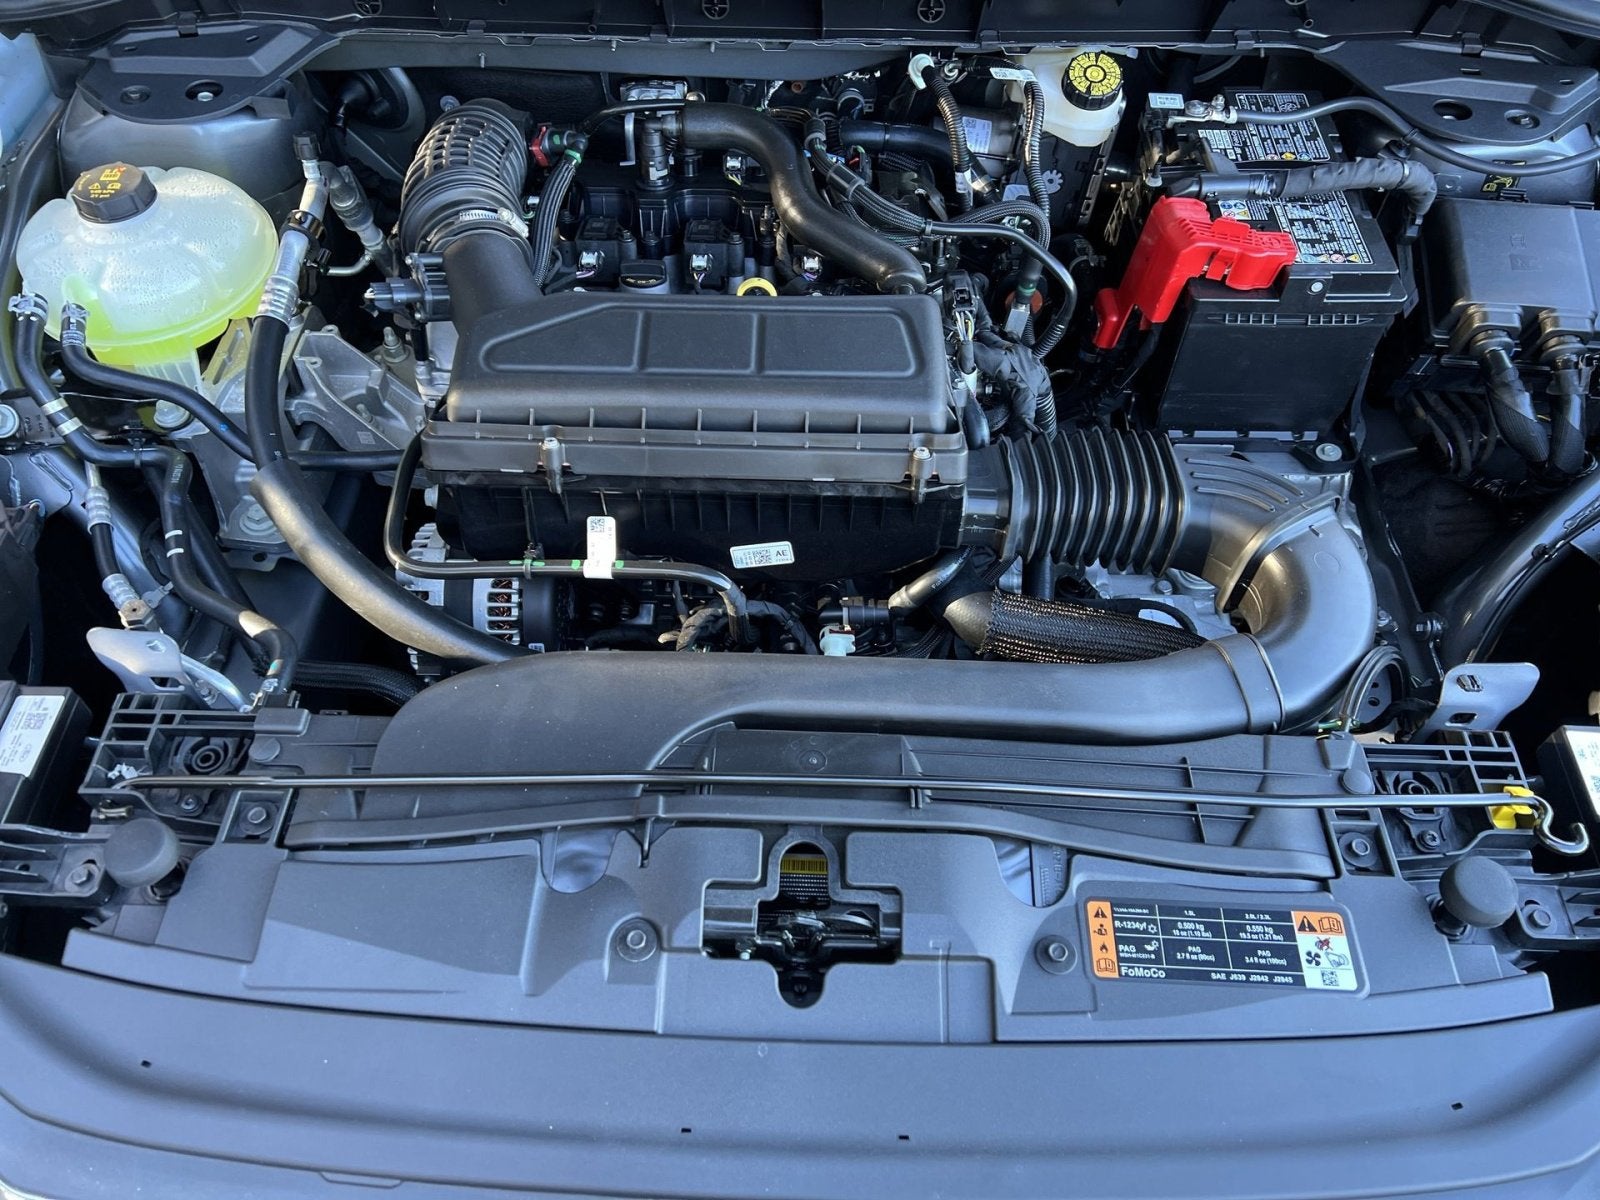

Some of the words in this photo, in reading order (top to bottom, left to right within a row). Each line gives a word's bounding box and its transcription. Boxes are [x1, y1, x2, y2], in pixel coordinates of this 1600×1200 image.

[776, 549, 788, 557] AE
[1114, 920, 1147, 930] R-1234yf
[1196, 923, 1204, 931] kg
[1265, 926, 1274, 934] kg
[1119, 944, 1136, 952] PAG
[1257, 949, 1271, 957] PAG
[1121, 966, 1166, 978] FoMoCo
[1211, 972, 1226, 980] SAE
